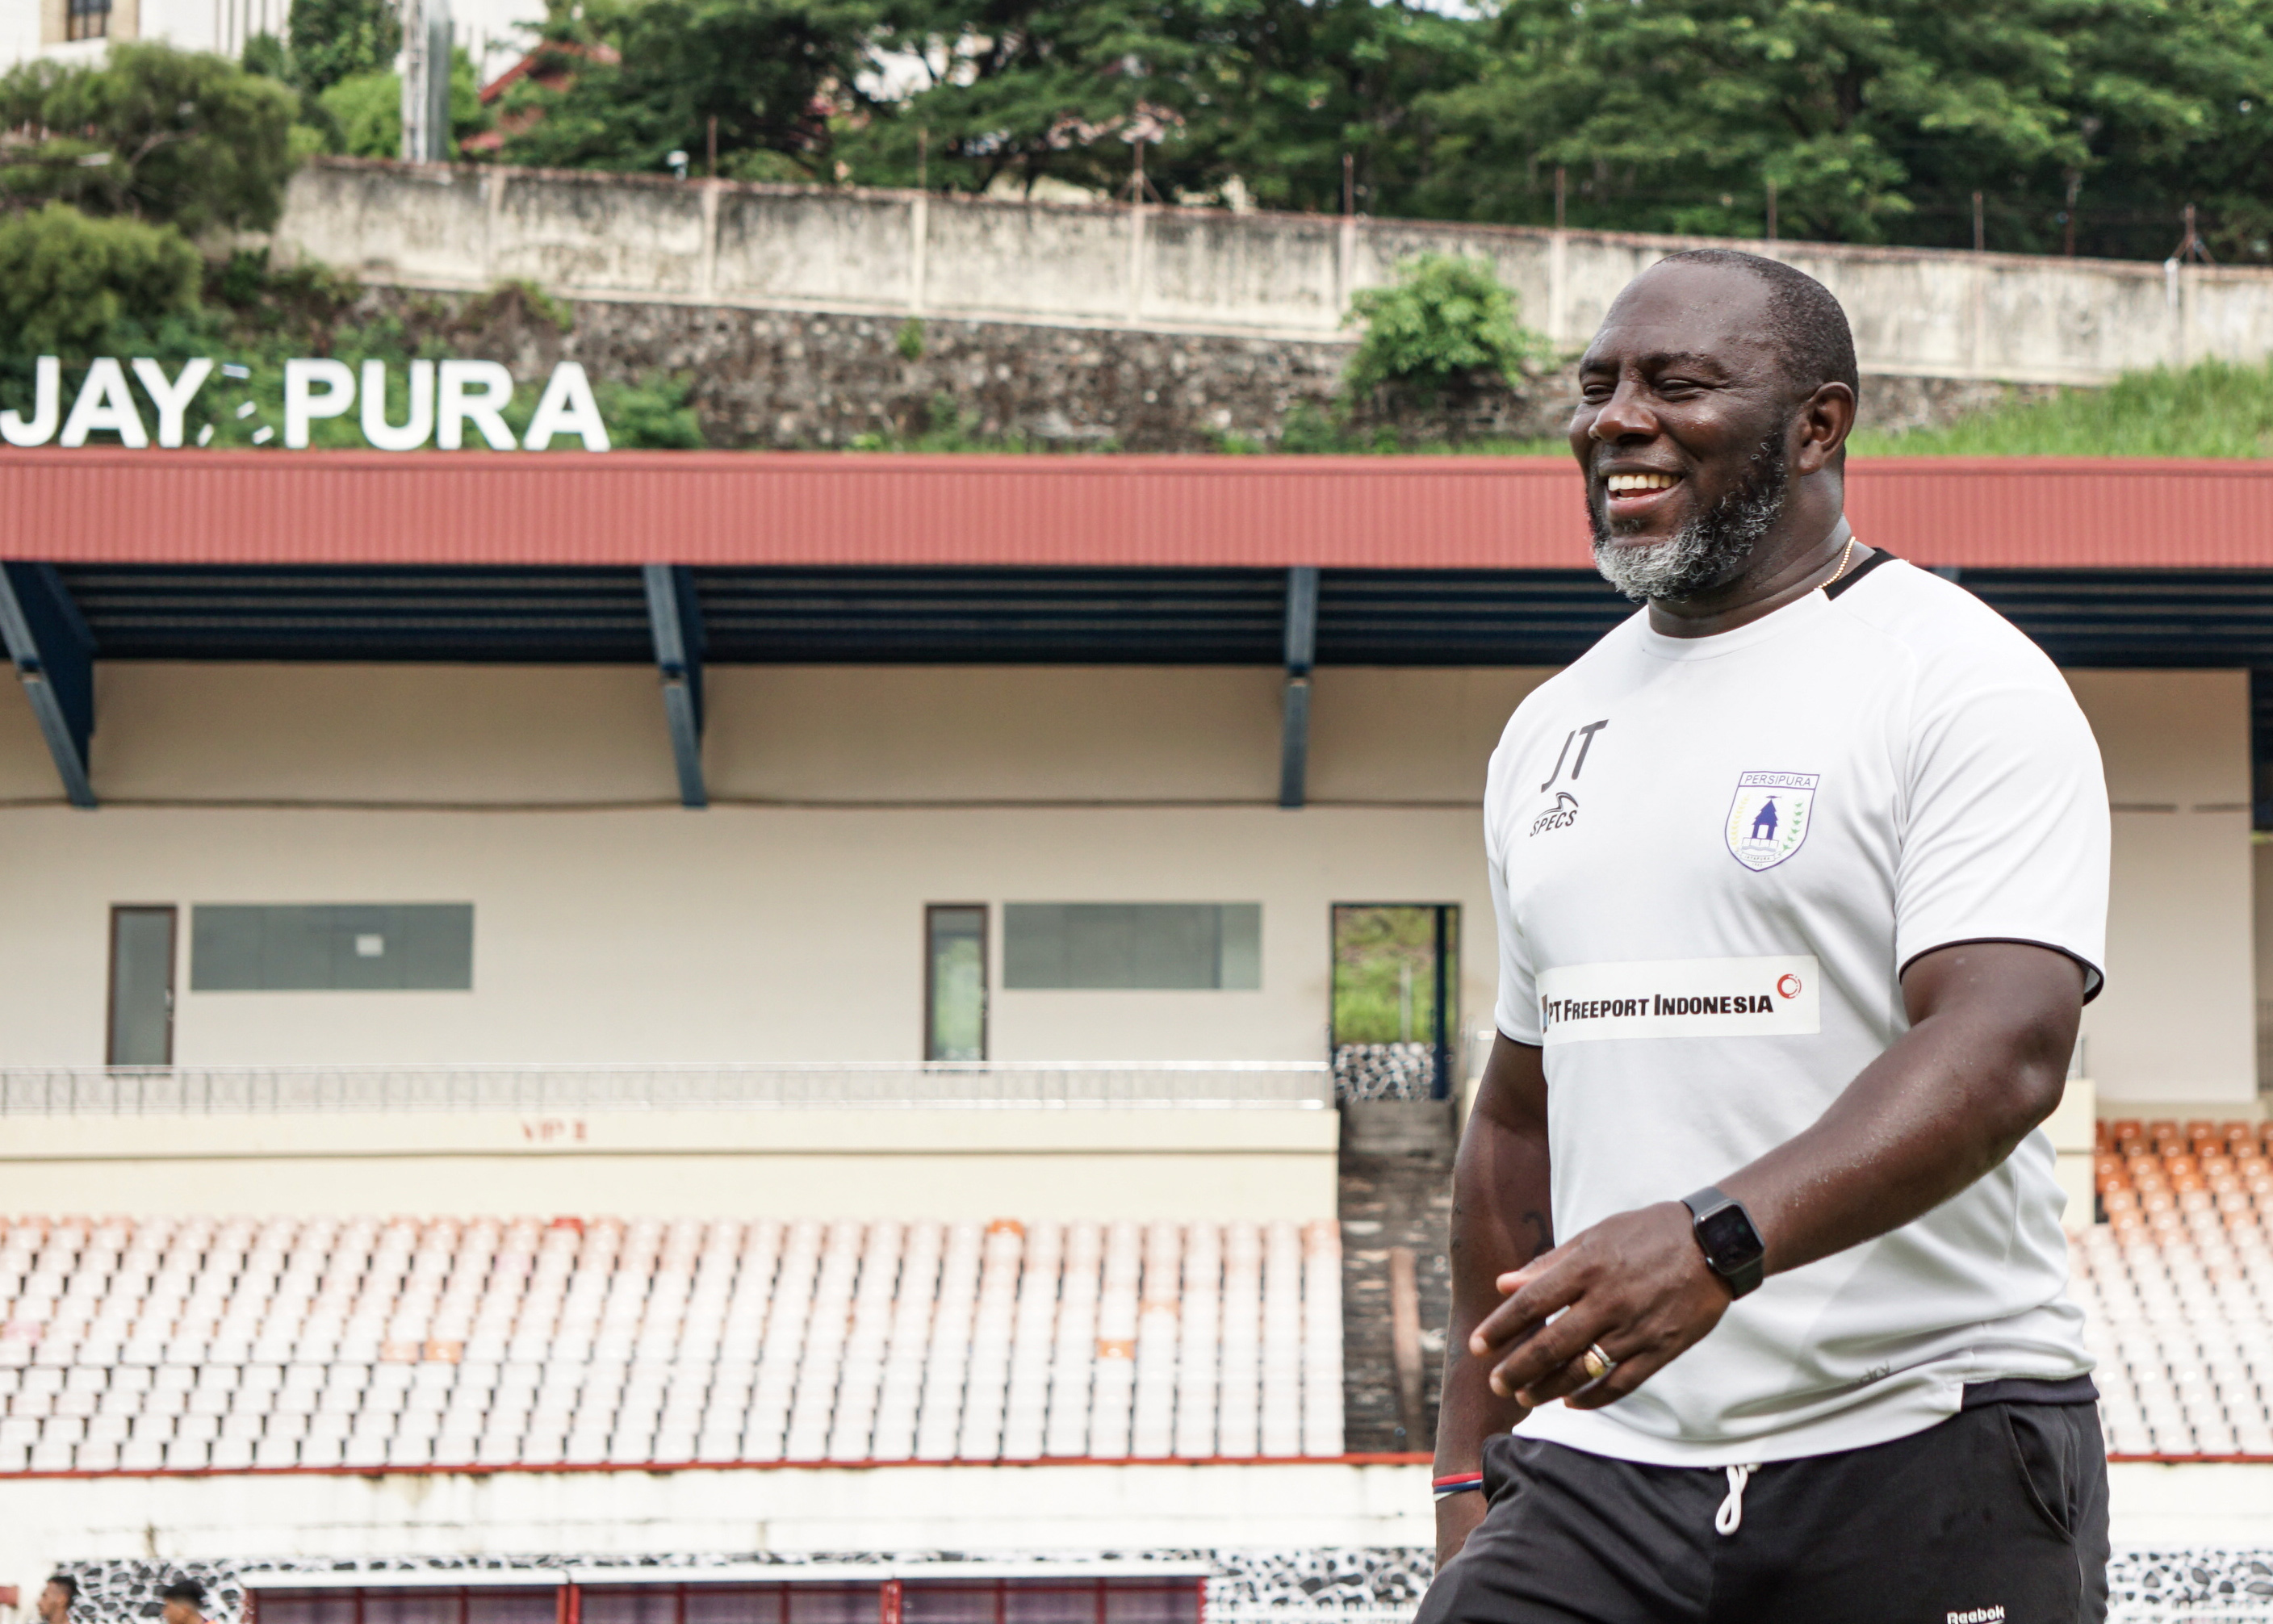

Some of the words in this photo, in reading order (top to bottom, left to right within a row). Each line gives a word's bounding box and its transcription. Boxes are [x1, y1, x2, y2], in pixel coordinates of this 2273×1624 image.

[1540, 719, 1610, 793] JT
[1744, 774, 1811, 787] PERSIPURA
[1529, 809, 1578, 838] SPECS
[1549, 1000, 1561, 1023] PT
[1564, 998, 1649, 1021] FREEPORT
[1655, 994, 1773, 1016] INDONESIA
[1946, 1604, 2006, 1624] Reebok
